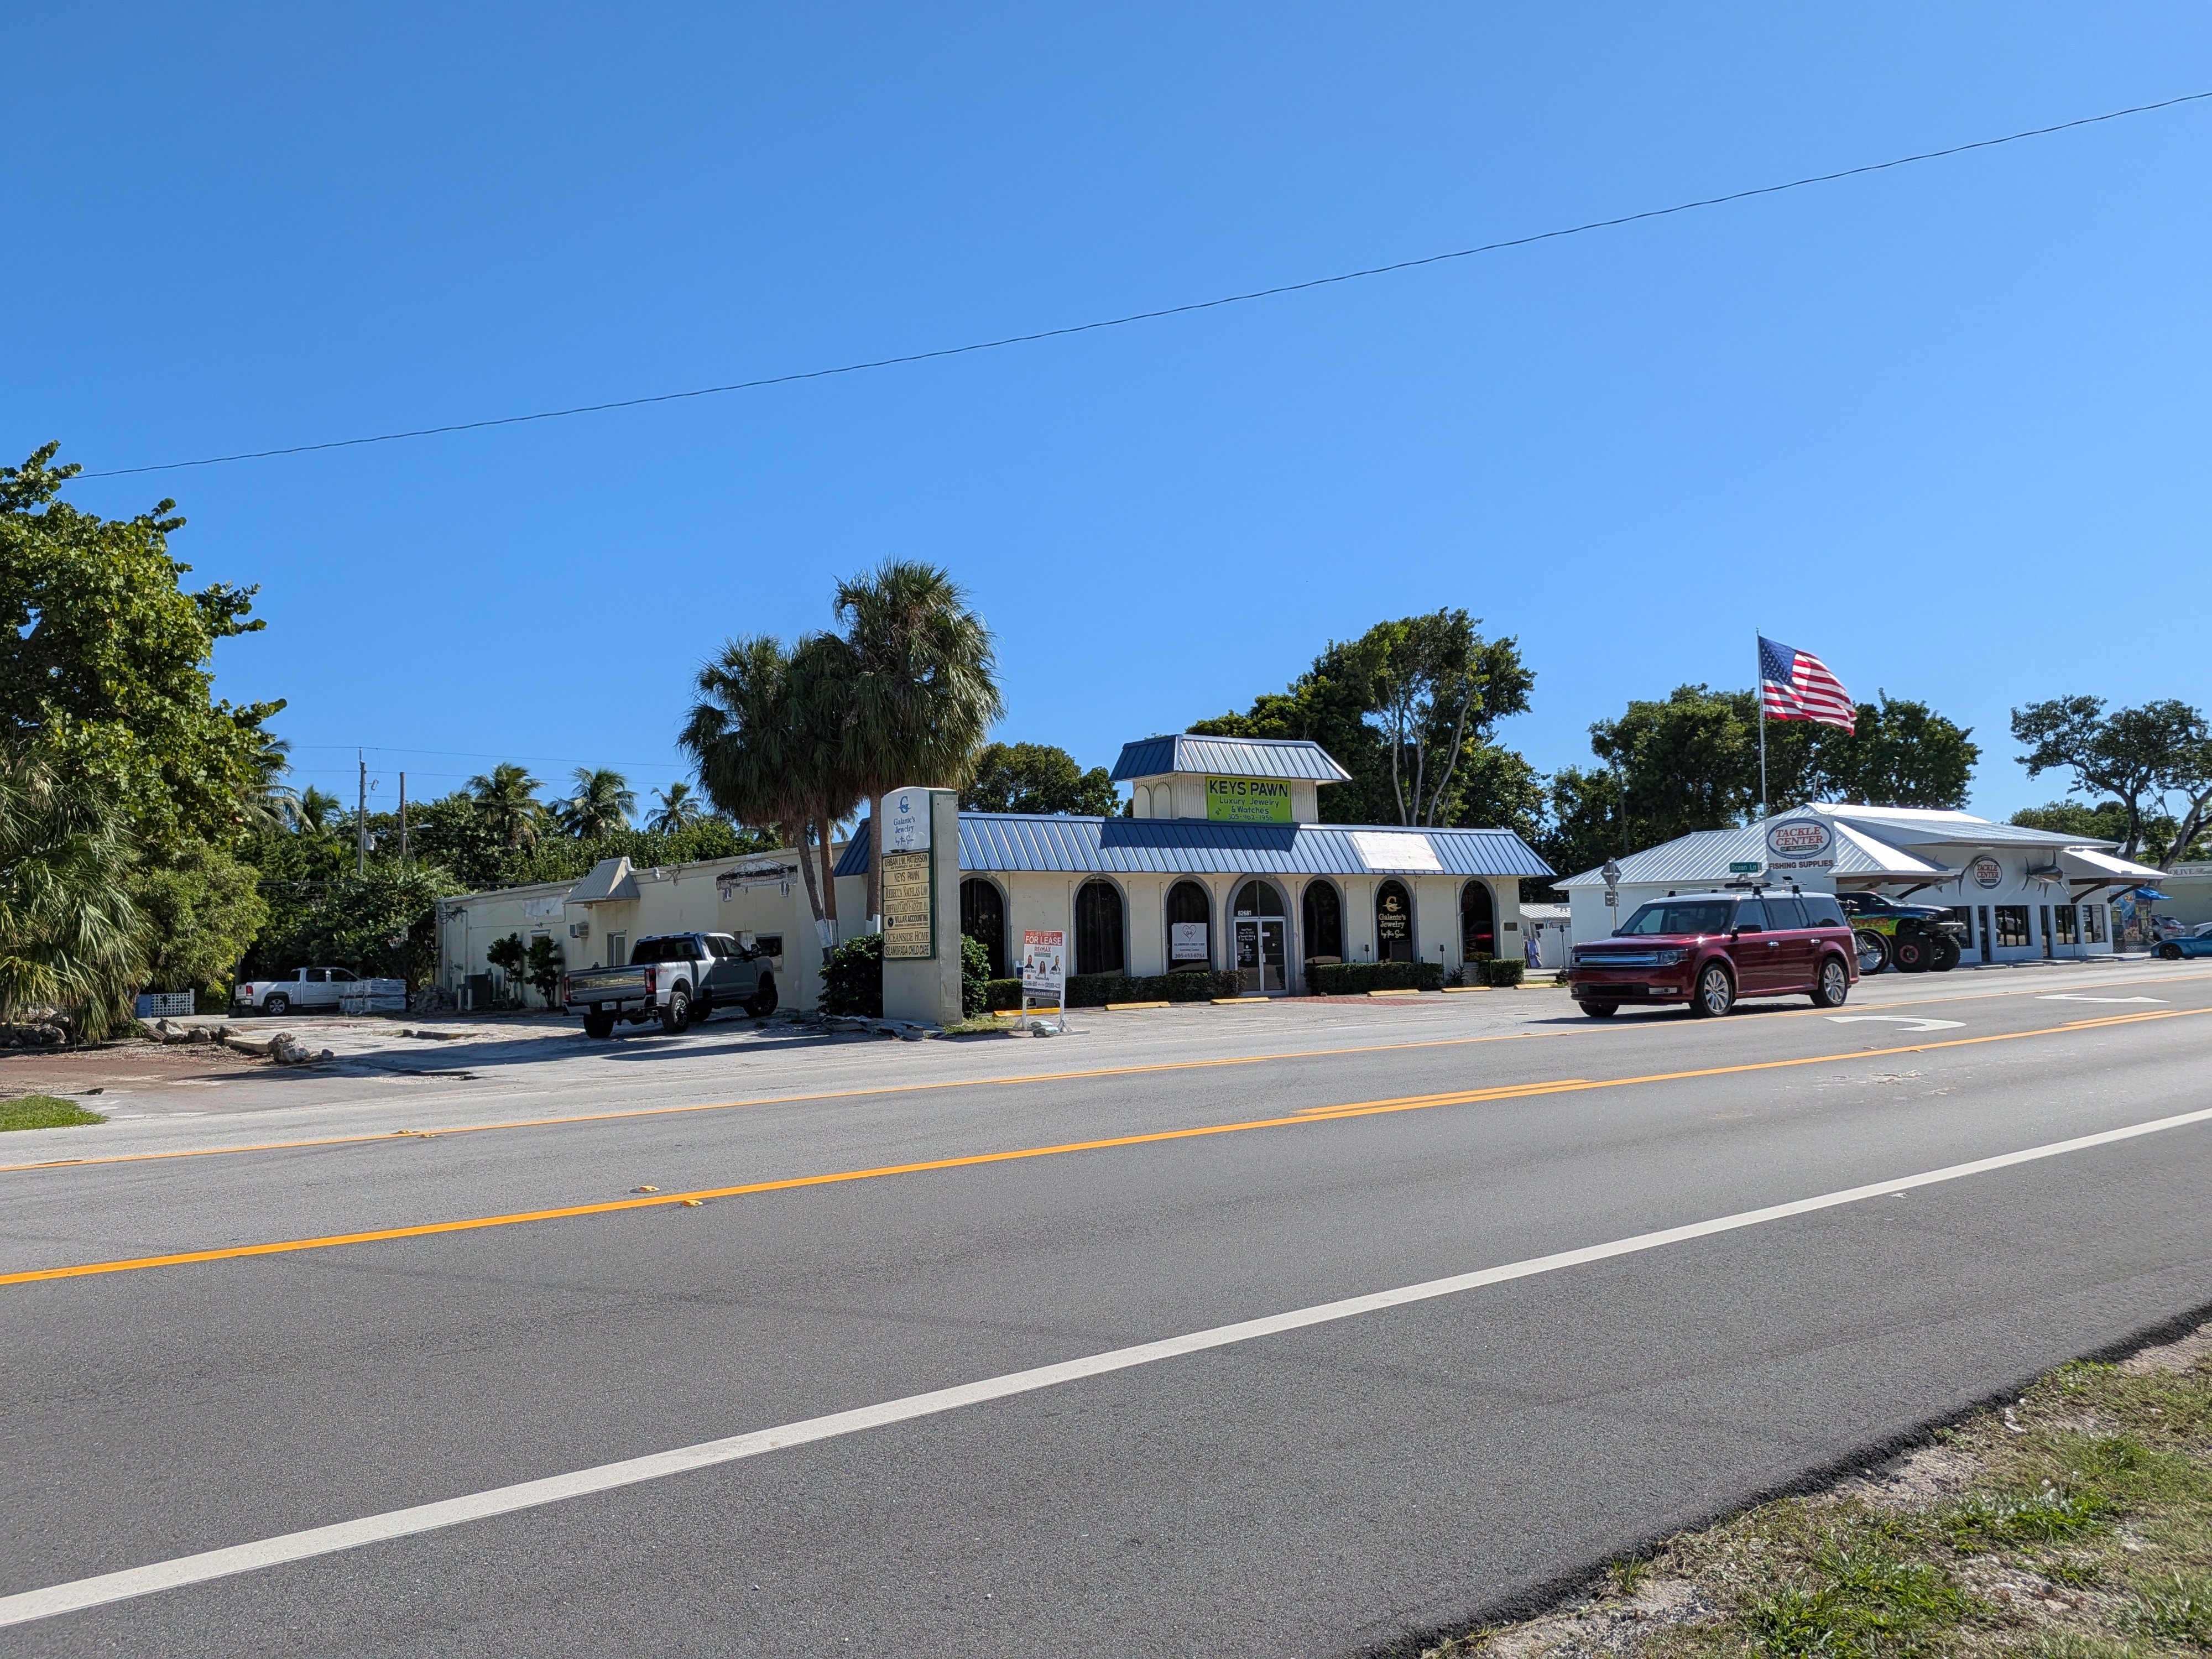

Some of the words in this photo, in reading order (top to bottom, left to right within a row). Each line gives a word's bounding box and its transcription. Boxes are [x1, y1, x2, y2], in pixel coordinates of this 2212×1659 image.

[1209, 780, 1246, 795] KEYS
[1250, 782, 1288, 797] PAWN
[1219, 797, 1245, 805] Luxury
[1250, 797, 1279, 808] Jewelry
[1237, 806, 1269, 815] Watches
[894, 816, 915, 826] Galante's
[895, 825, 914, 833] Jewelry
[1776, 827, 1821, 837] TACKLE
[895, 837, 900, 846] by
[1776, 836, 1824, 846] CENTER
[885, 858, 898, 867] URBAN
[907, 854, 928, 864] PATTERSON
[1799, 860, 1833, 868] SUPPLIES
[894, 872, 906, 883] KEYS
[907, 870, 920, 881] PAWN
[885, 932, 913, 942] OCEANSIDE
[915, 931, 928, 941] HOME
[1025, 936, 1039, 944] FOR
[1040, 936, 1062, 945] LEASE
[885, 946, 907, 956] ISLAMORADA
[909, 945, 919, 955] CHILD
[920, 945, 928, 955] CARE
